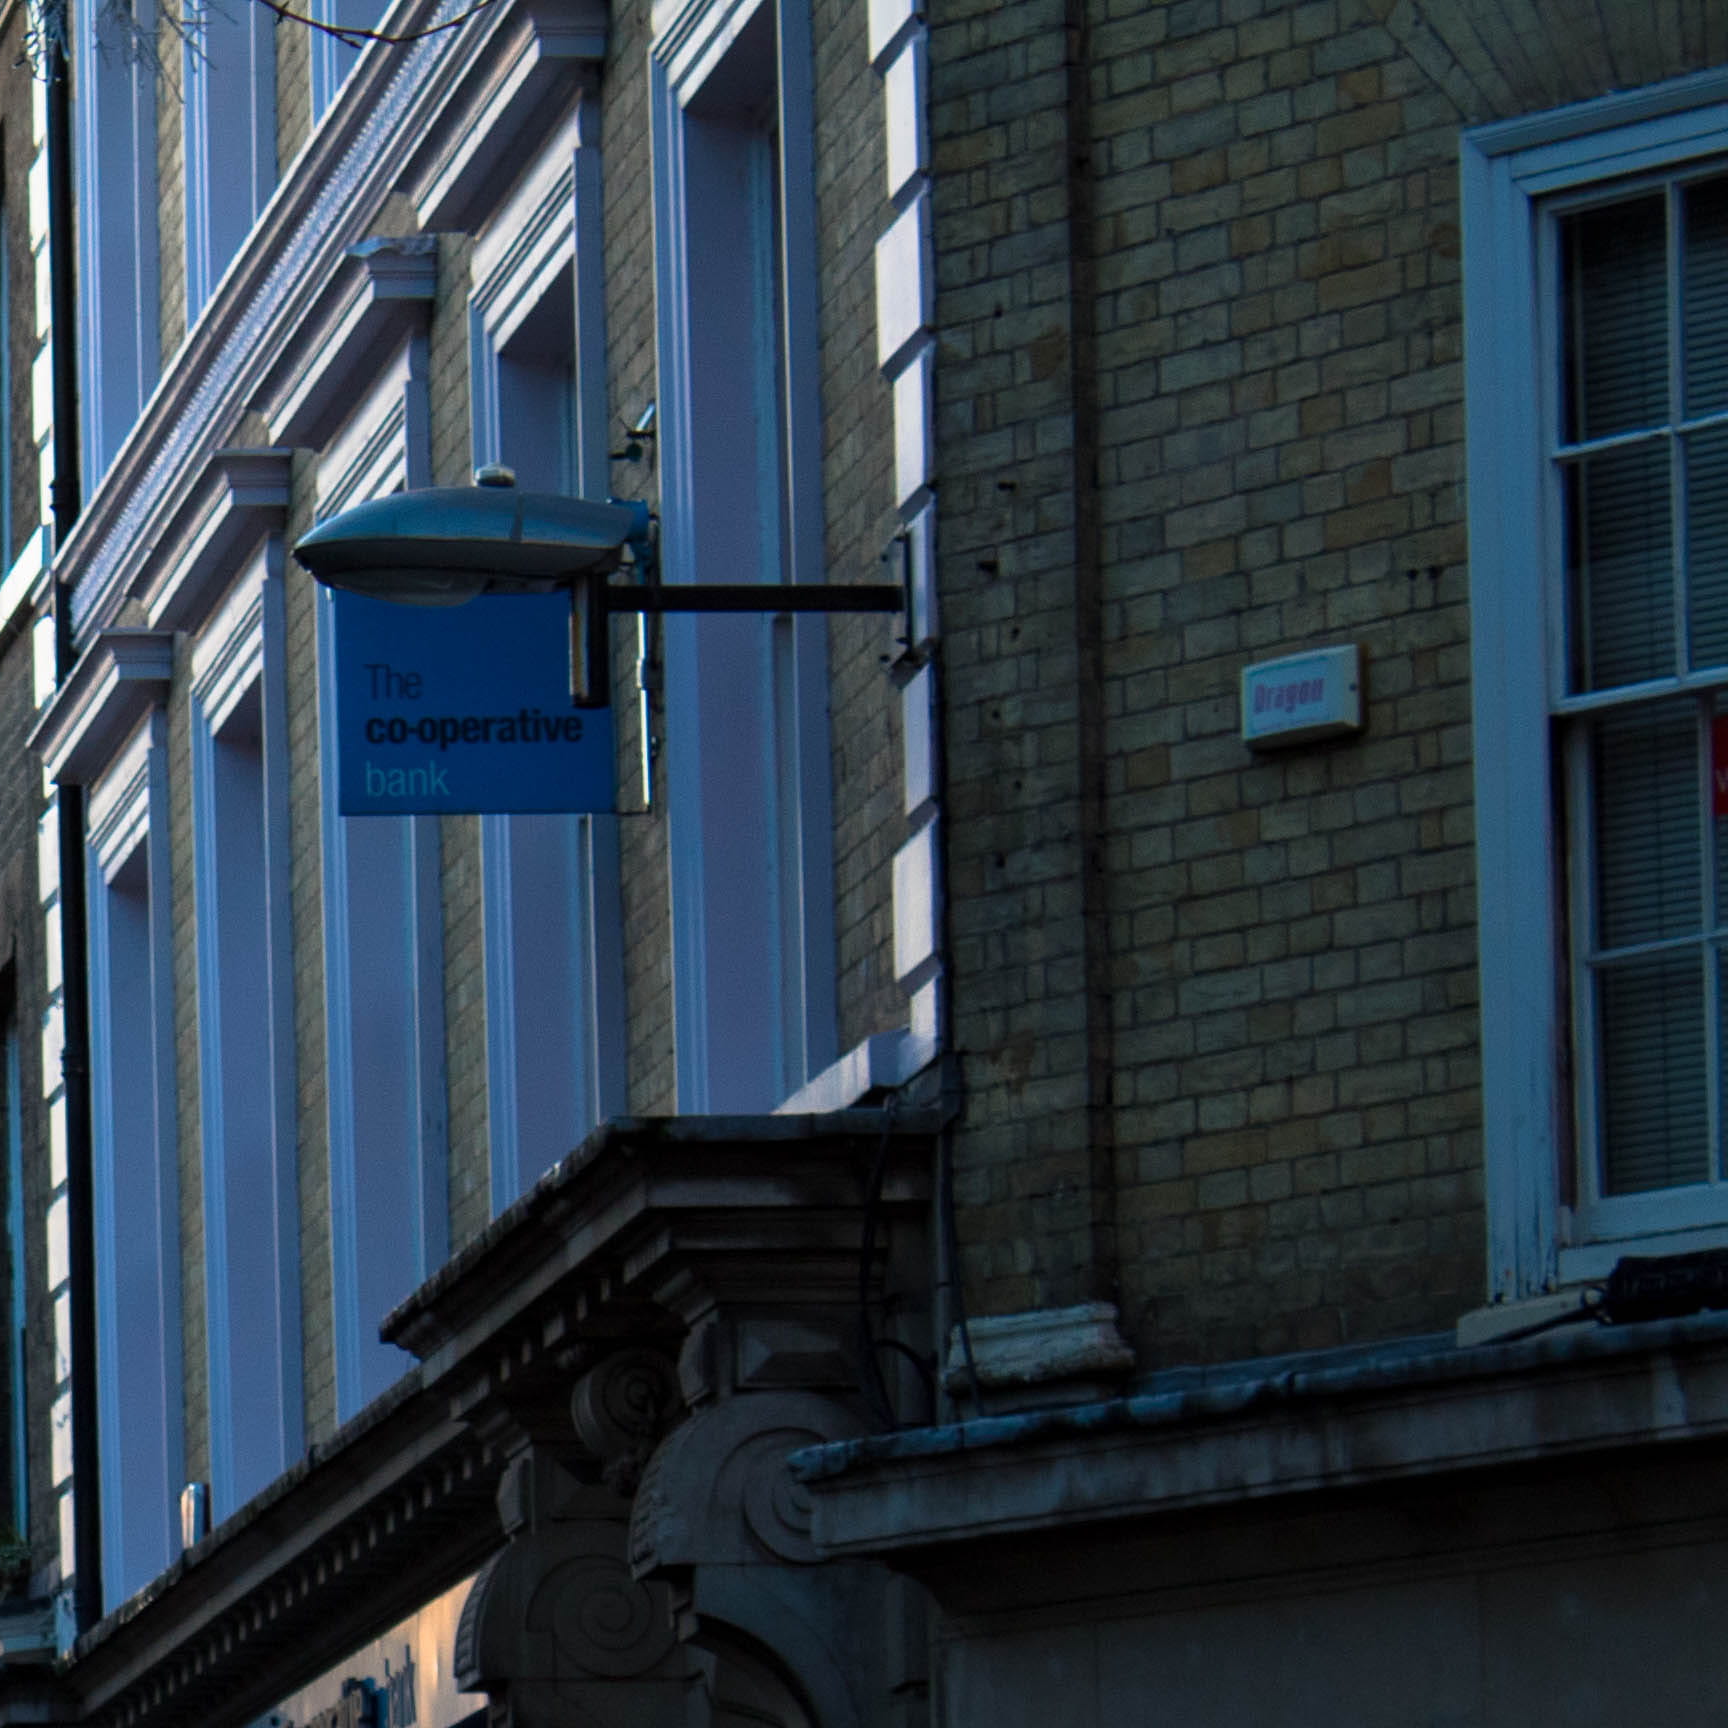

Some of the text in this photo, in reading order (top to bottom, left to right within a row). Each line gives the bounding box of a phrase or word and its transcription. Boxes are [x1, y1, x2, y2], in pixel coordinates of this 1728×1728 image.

[365, 664, 422, 700] The
[366, 709, 584, 751] co-operative
[365, 760, 451, 797] bank
